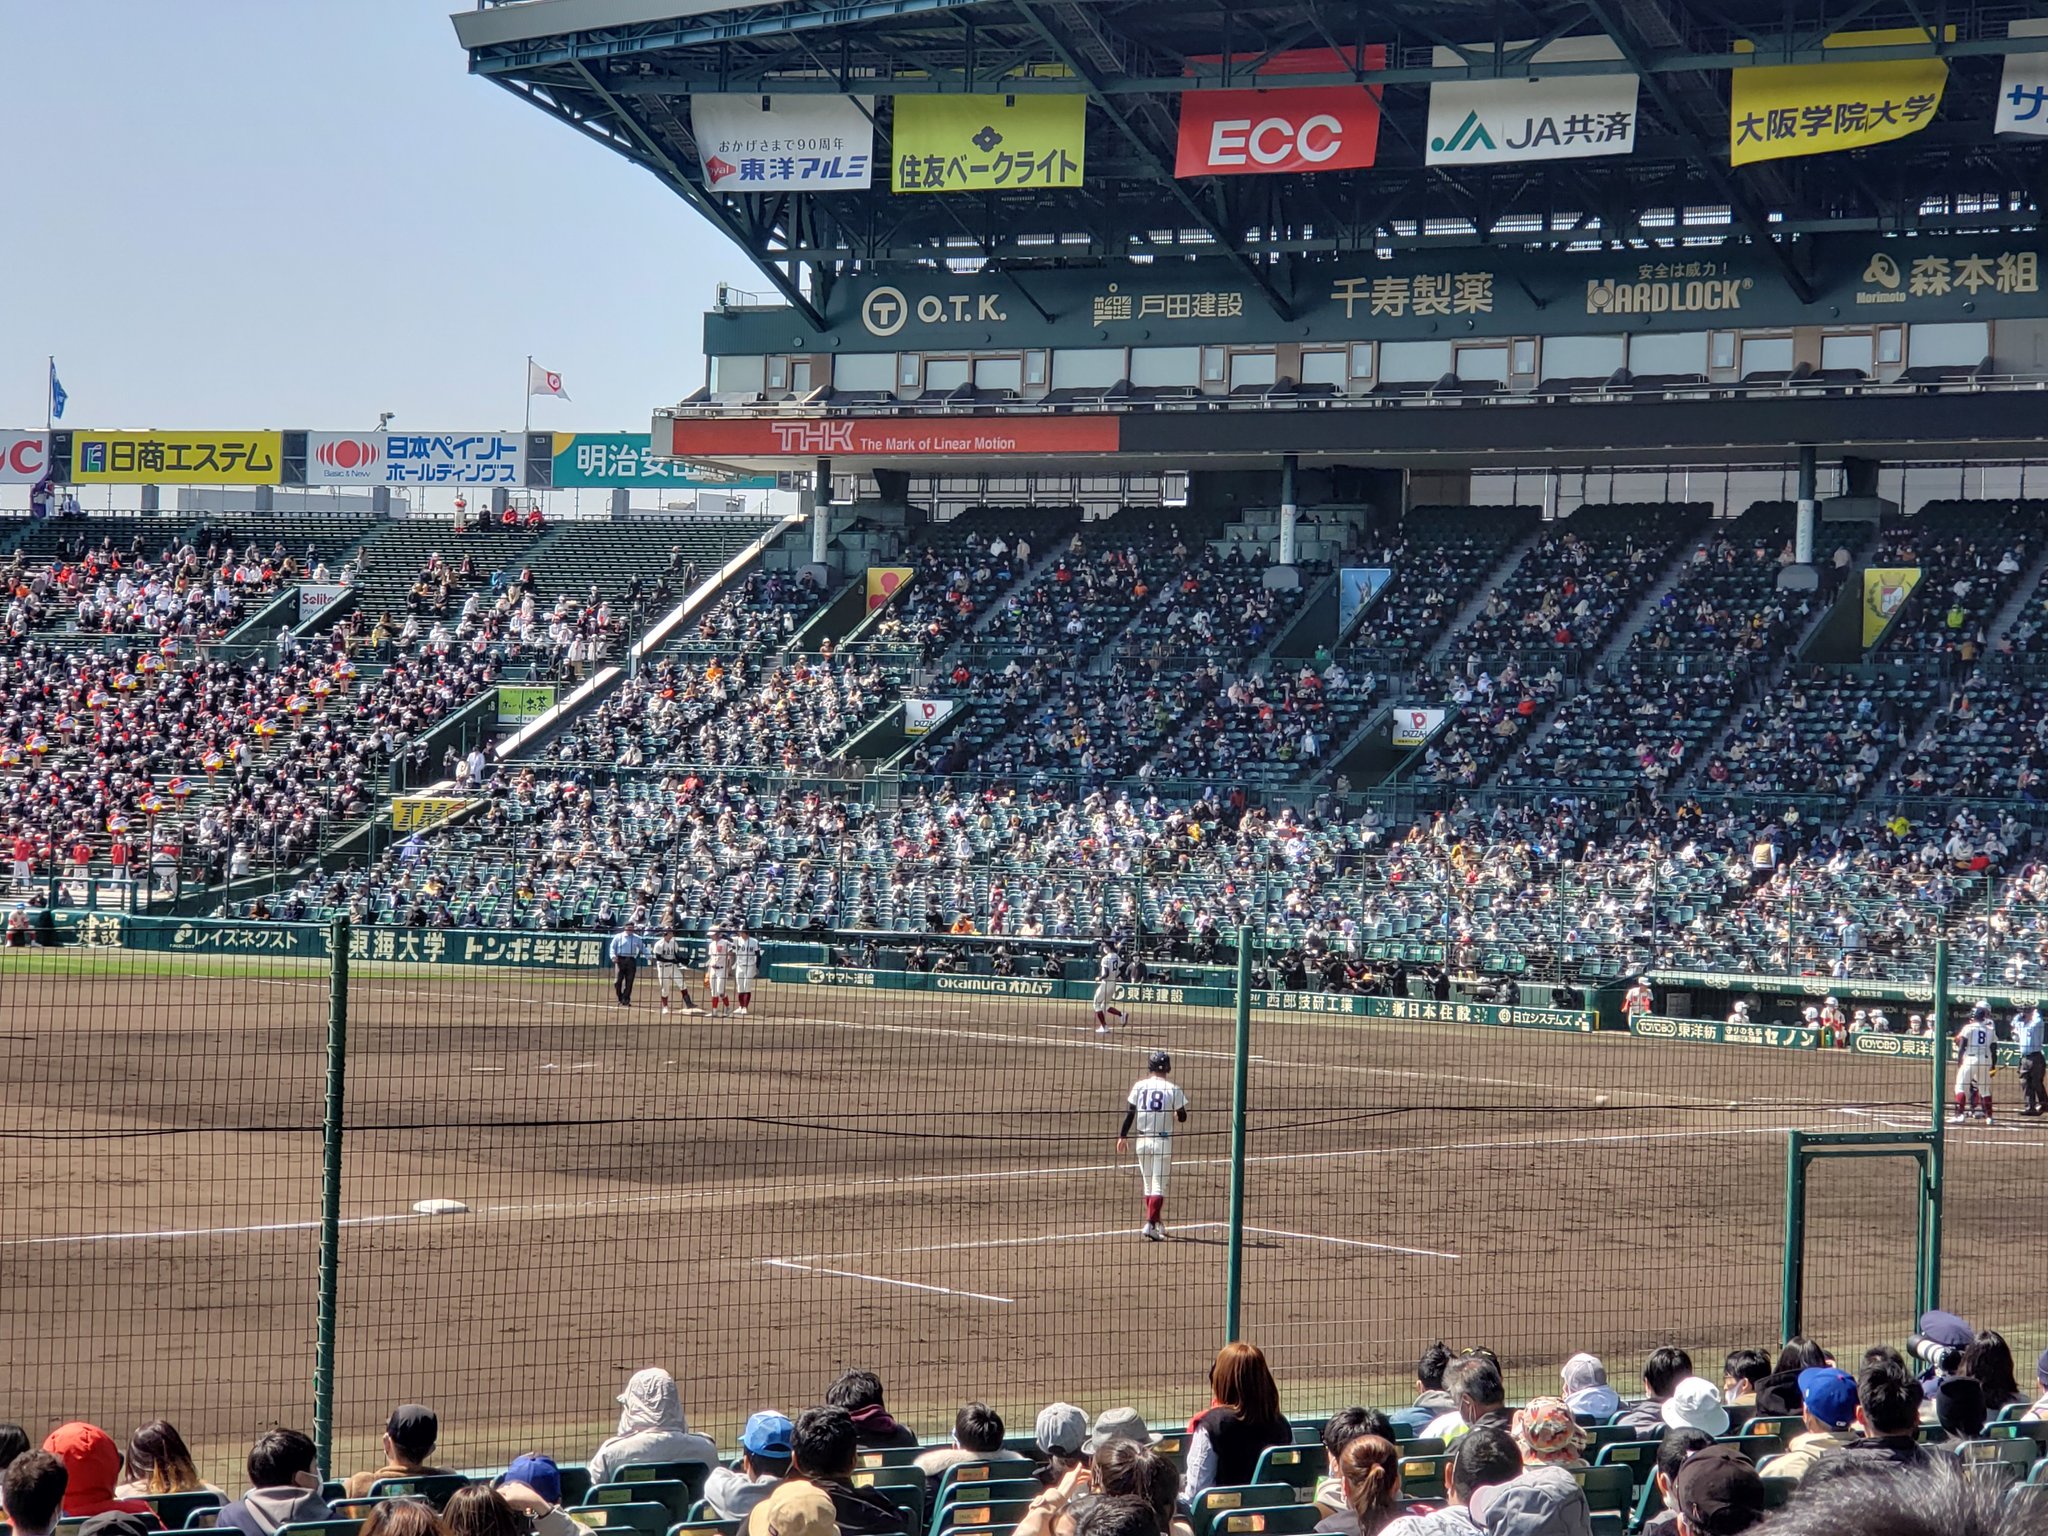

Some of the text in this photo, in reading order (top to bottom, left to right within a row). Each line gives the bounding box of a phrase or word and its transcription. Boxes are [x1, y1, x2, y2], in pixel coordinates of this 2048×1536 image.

[1506, 112, 1631, 149] JA共済
[1736, 93, 1936, 146] 大阪学院大学
[719, 137, 844, 153] おかげさまで90周年
[1208, 114, 1342, 165] ECC
[739, 155, 868, 181] 東洋アルミ
[899, 148, 1078, 189] 住友ベークライト
[1909, 251, 2039, 297] 森本組
[1138, 292, 1243, 319] 戸田建設
[1331, 272, 1494, 318] 千寿製薬
[1856, 292, 1906, 304] Morimoto
[917, 294, 1007, 323] O.T.K.
[387, 436, 517, 460] 日本ペイント
[771, 421, 1016, 451] THK The Mark of Linear Motion
[111, 440, 273, 472] 日商エステム
[386, 463, 516, 482] ホールディングス
[195, 928, 298, 949] レイズネクスト
[347, 928, 446, 962] 東海大学
[465, 936, 603, 966] トンボ学生服
[1009, 980, 1053, 995] オカムラ
[1127, 987, 1184, 1003] 東洋建設
[1267, 992, 1353, 1013] 西部技研工業
[1513, 1011, 1573, 1026] 日立システムズ
[1640, 1022, 1673, 1033] TOYOBO
[1678, 1022, 1716, 1039] 東洋紡
[1765, 1028, 1815, 1046] セノン
[1860, 1039, 1897, 1050] TOYOBO
[1977, 1031, 1986, 1045] 8
[1141, 1090, 1164, 1111] 18
